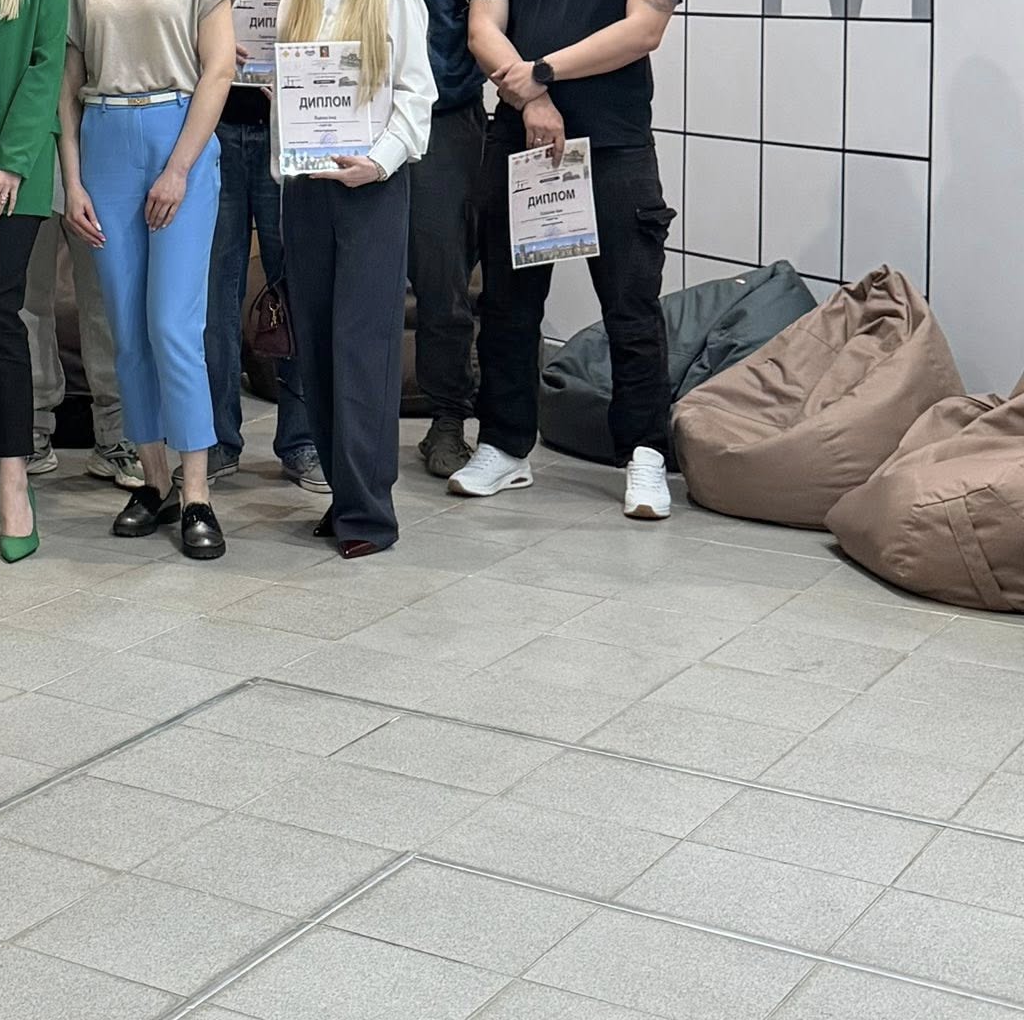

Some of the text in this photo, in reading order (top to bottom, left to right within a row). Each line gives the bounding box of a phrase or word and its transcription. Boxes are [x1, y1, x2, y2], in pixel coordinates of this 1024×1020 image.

[249, 17, 276, 29] ДИПЛ
[299, 95, 351, 111] ДИПЛОМ
[528, 189, 575, 209] ДИПЛОМ
